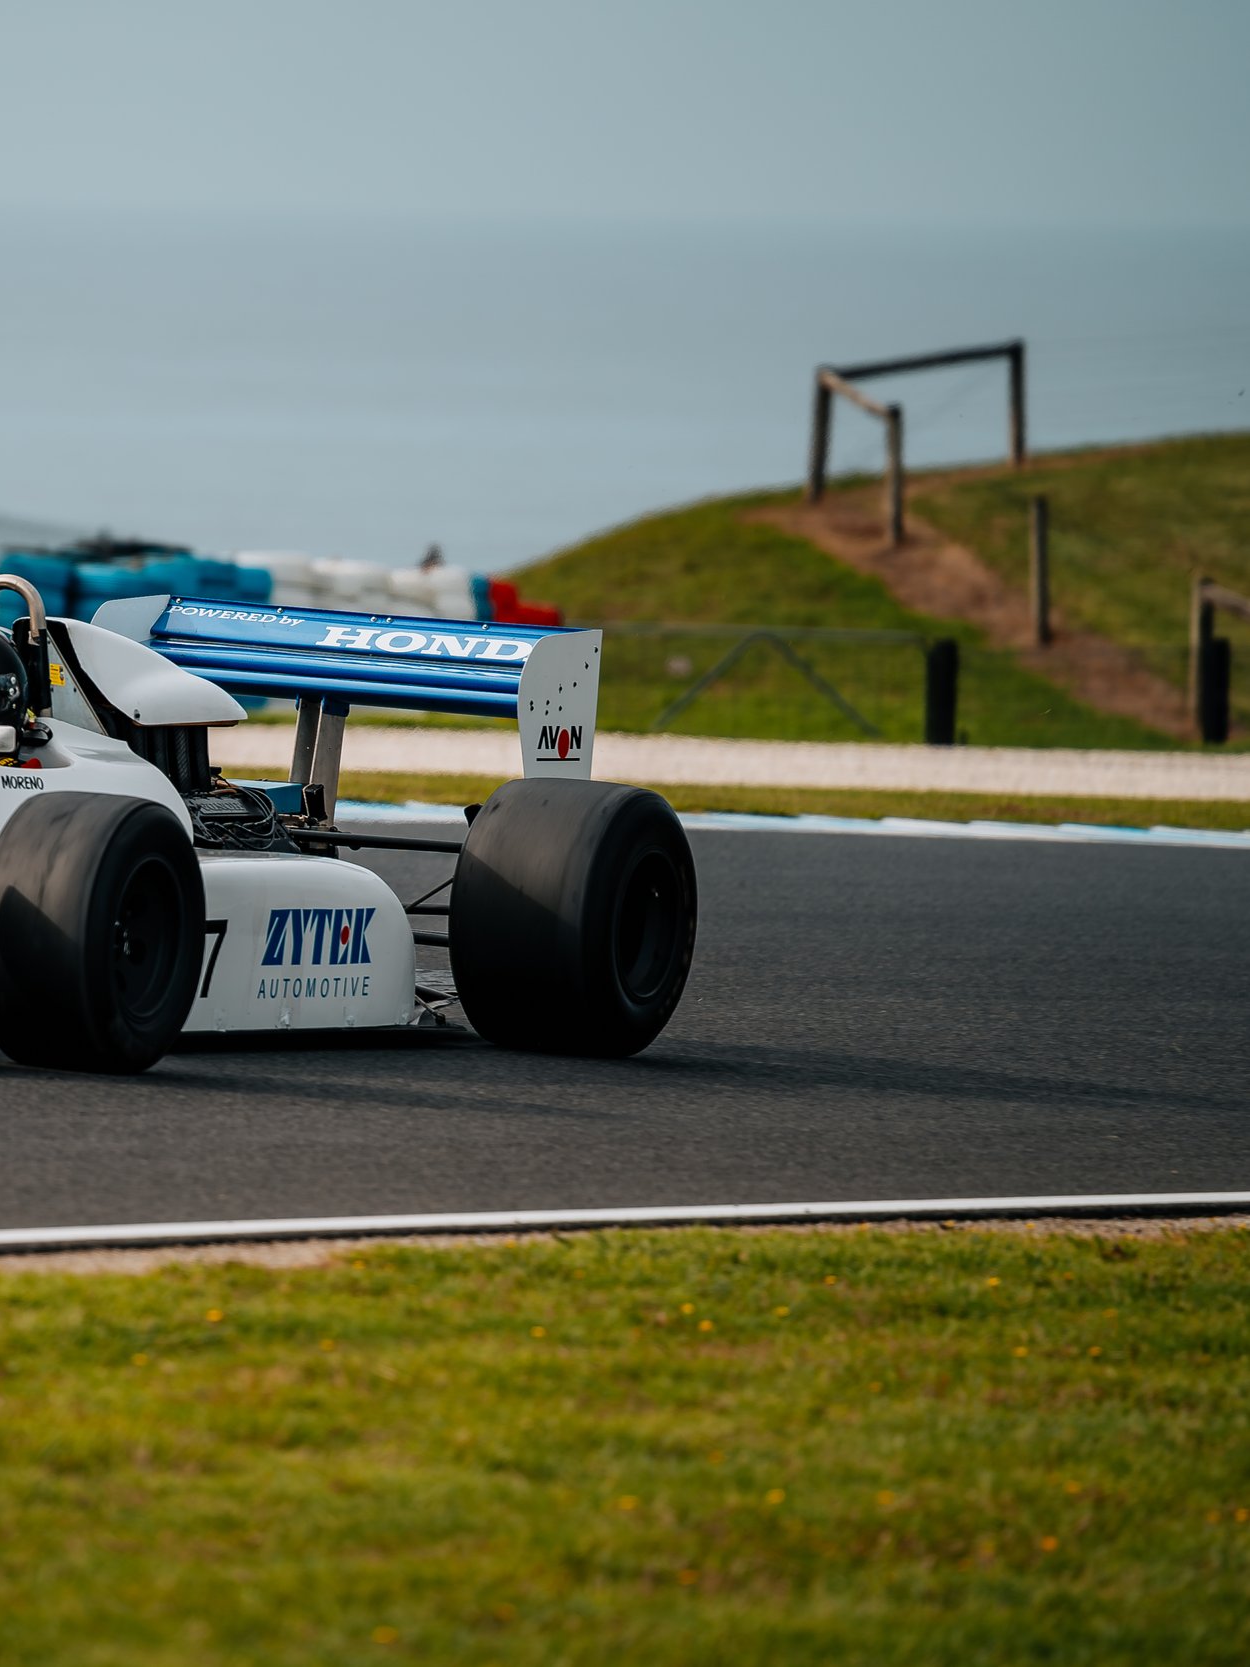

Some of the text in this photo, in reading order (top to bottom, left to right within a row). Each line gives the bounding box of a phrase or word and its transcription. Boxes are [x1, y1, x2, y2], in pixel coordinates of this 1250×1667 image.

[167, 605, 305, 627] POWERED by
[315, 626, 534, 662] HOND
[537, 725, 583, 759] AVON
[1, 775, 44, 790] MORENO
[261, 908, 376, 966] ZYTEK
[257, 976, 370, 999] AUTOMOTIVE
